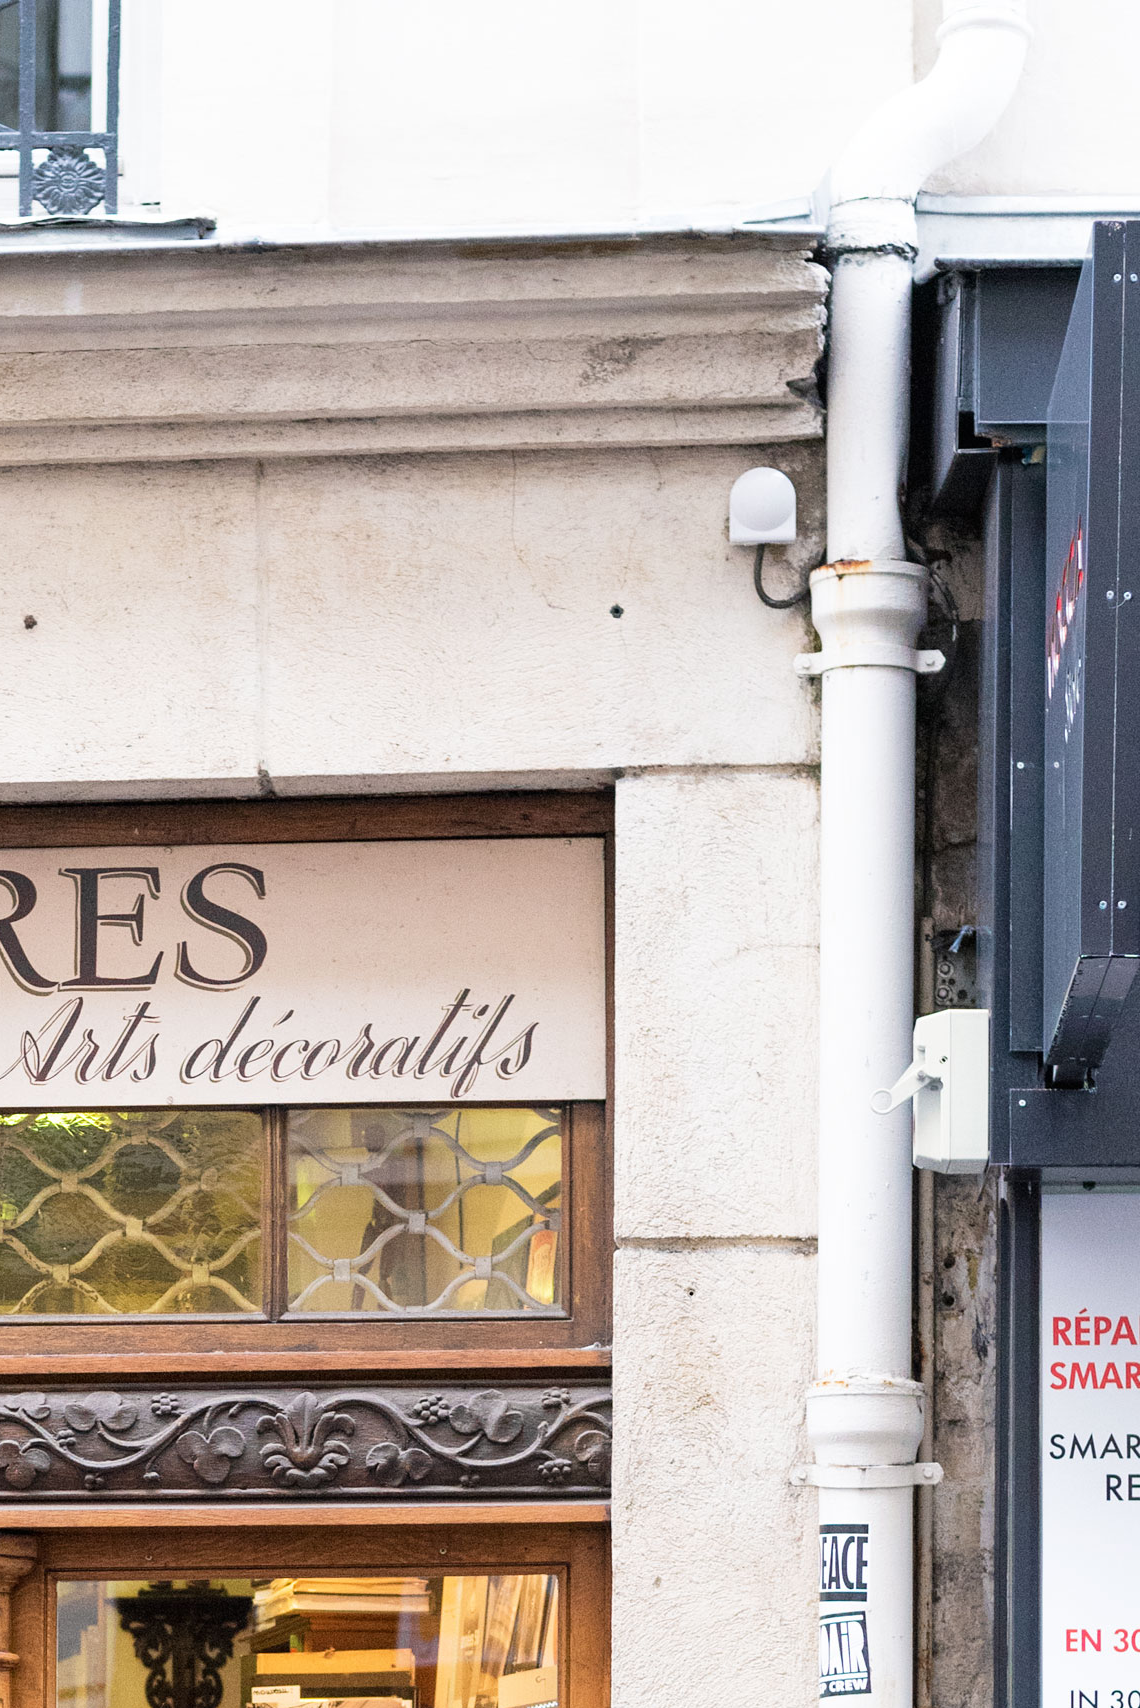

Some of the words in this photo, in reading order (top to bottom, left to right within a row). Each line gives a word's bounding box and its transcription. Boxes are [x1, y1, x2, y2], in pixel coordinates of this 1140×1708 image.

[180, 989, 539, 1098] décoratifs
[820, 1535, 868, 1590] EACE
[1065, 1629, 1102, 1653] EN
[829, 1679, 868, 1693] CREW
